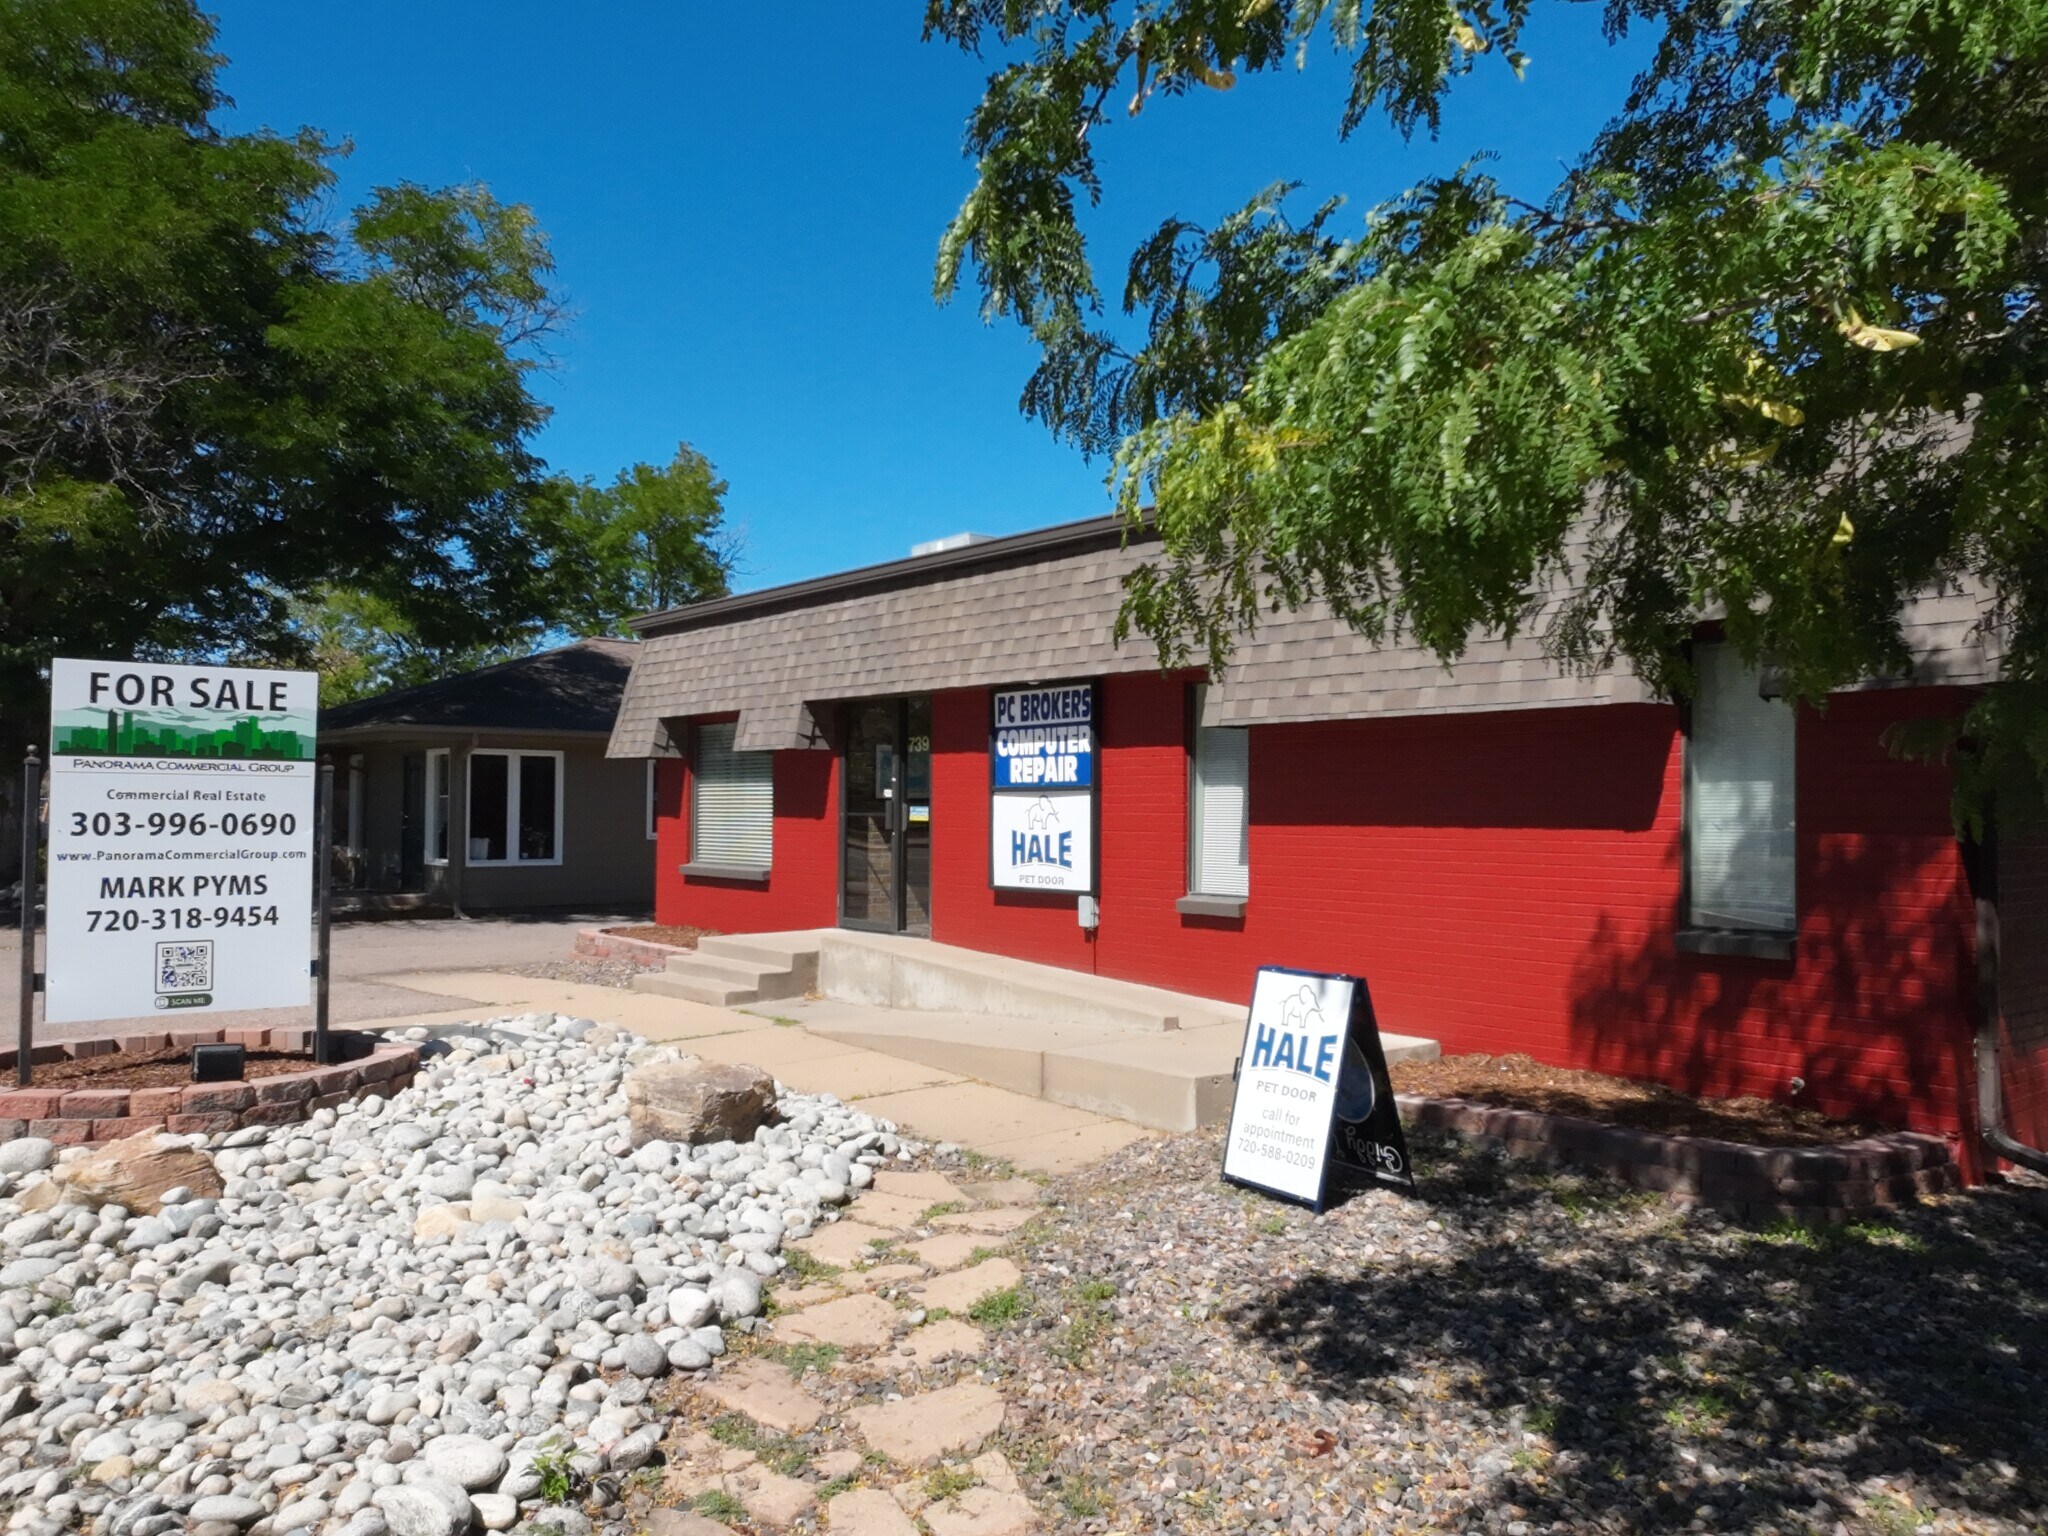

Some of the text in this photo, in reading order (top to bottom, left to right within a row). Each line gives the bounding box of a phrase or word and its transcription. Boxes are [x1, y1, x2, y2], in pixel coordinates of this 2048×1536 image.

[89, 671, 287, 712] FOR SALE
[997, 688, 1091, 723] PC BROKERS
[908, 736, 930, 753] 739
[997, 725, 1091, 757] COMPUTER
[73, 758, 295, 773] PANORAMA COMMERCIAL GROUP
[1010, 755, 1078, 784] REPAIR
[106, 788, 266, 802] Commercial Real Estate
[70, 811, 297, 836] 303-996-0690
[56, 849, 307, 862] www.PanoramaCommercialGroup.com
[1011, 829, 1073, 869] HALE
[99, 874, 268, 899] MARK PYMS
[1019, 874, 1065, 886] PET DOOR
[86, 905, 279, 932] 720-318-9454
[1251, 1022, 1338, 1083] HALE
[1256, 1080, 1317, 1102] PET DOOR
[1262, 1107, 1301, 1126] call for
[1243, 1122, 1315, 1150] appointment
[1238, 1137, 1316, 1170] 720-588-0209
